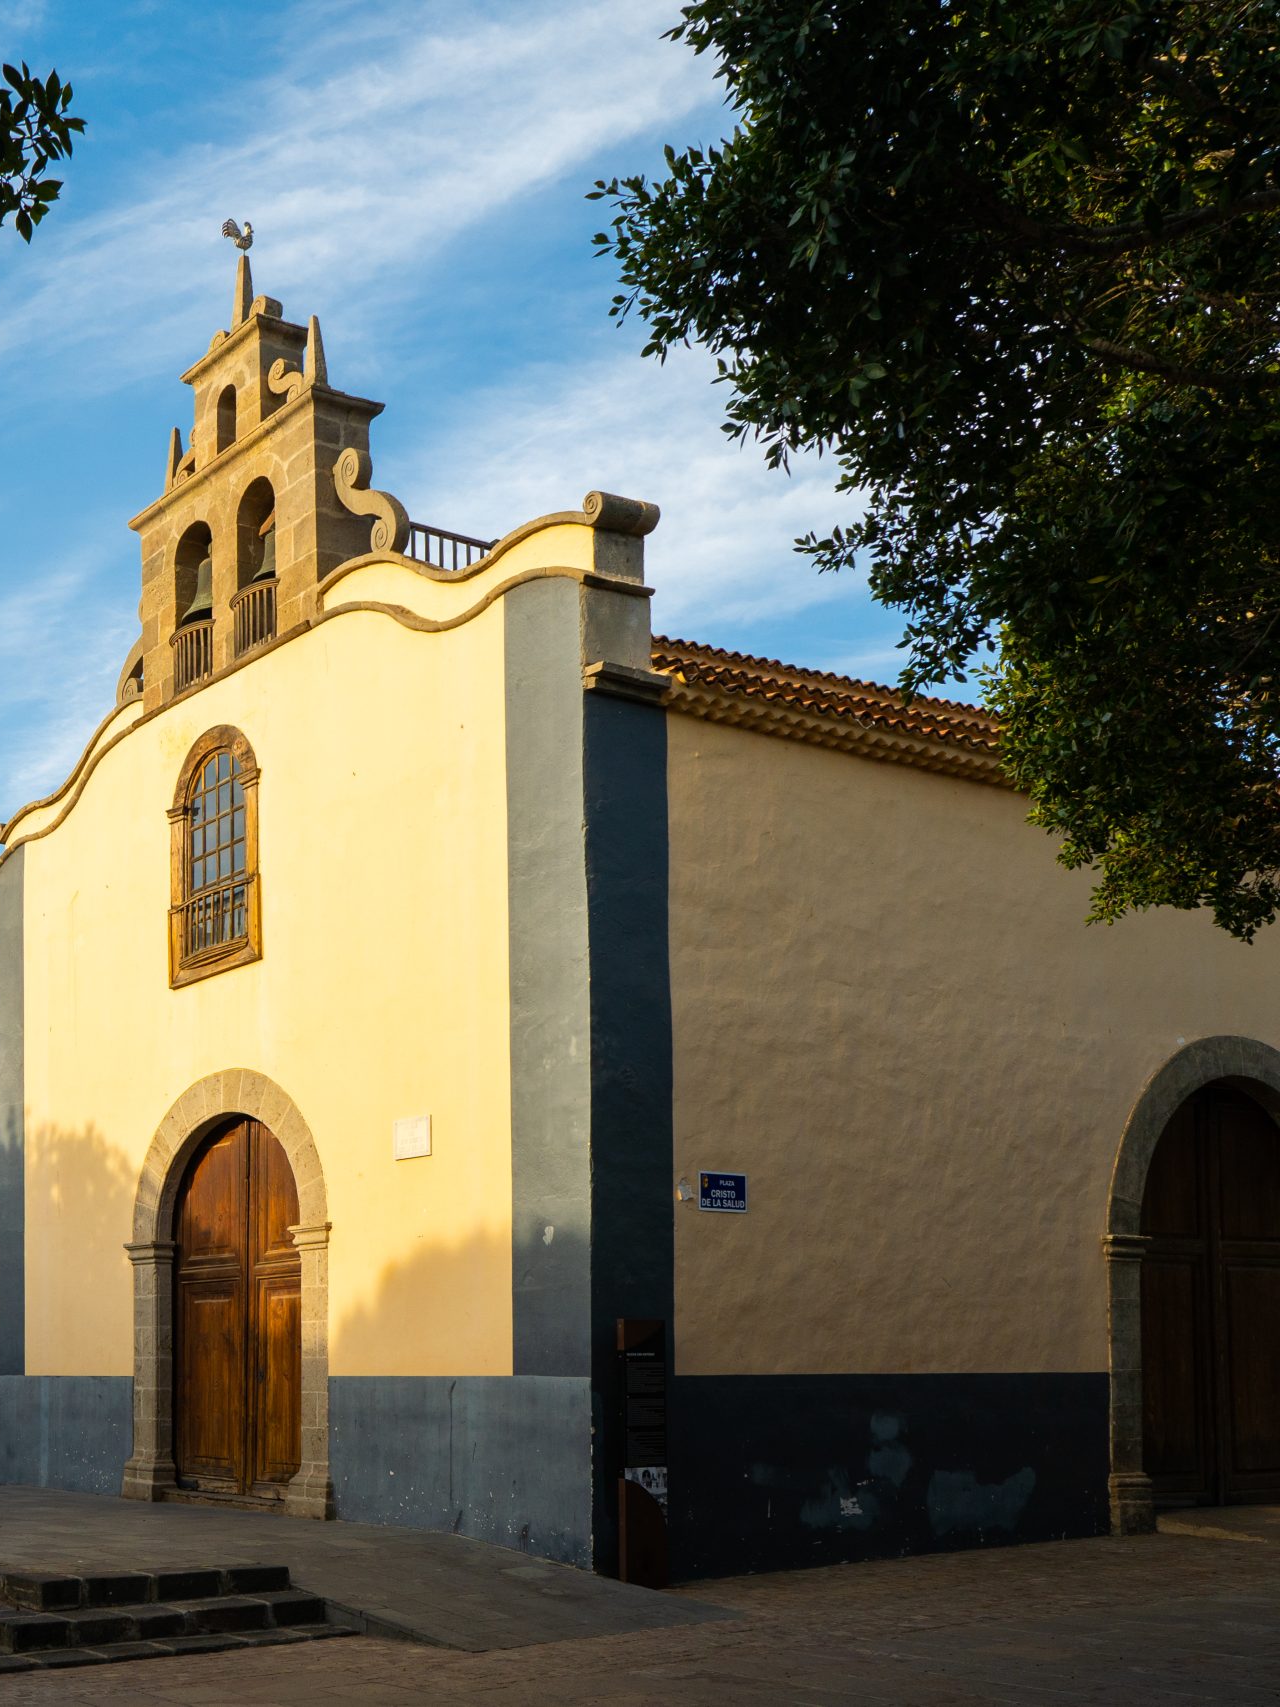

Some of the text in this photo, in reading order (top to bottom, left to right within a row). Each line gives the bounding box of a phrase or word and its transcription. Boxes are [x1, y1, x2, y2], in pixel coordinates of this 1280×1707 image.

[710, 1189, 736, 1199] CRISTO
[701, 1198, 745, 1209] DE LA SALUD
